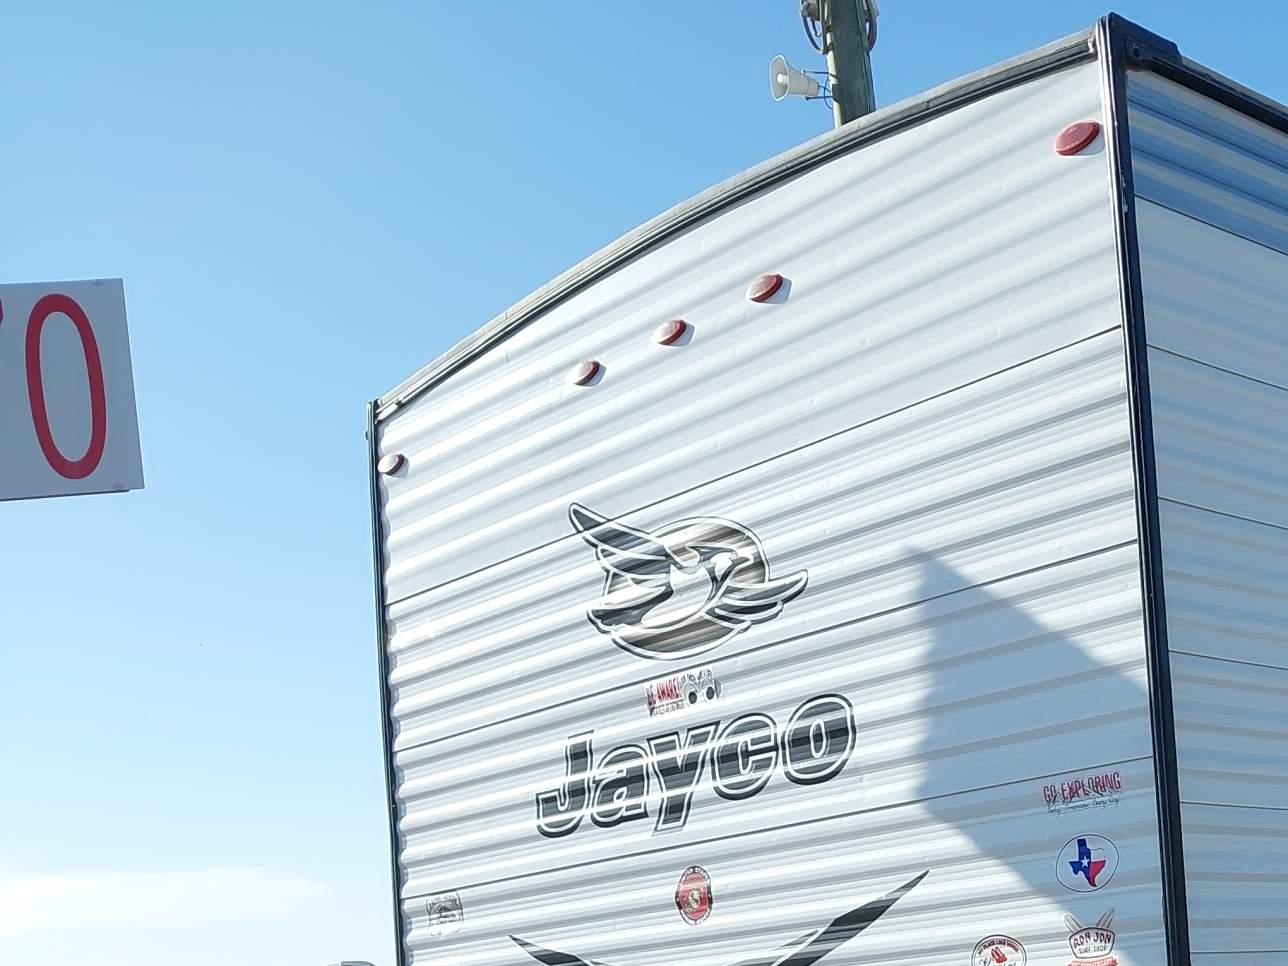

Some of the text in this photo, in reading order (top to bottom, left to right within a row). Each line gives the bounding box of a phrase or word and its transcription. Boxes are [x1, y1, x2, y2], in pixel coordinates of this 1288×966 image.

[535, 692, 857, 839] Jayco
[1043, 784, 1057, 805] GO
[1060, 771, 1121, 803] EXPLORING
[1073, 931, 1112, 949] RON JON
